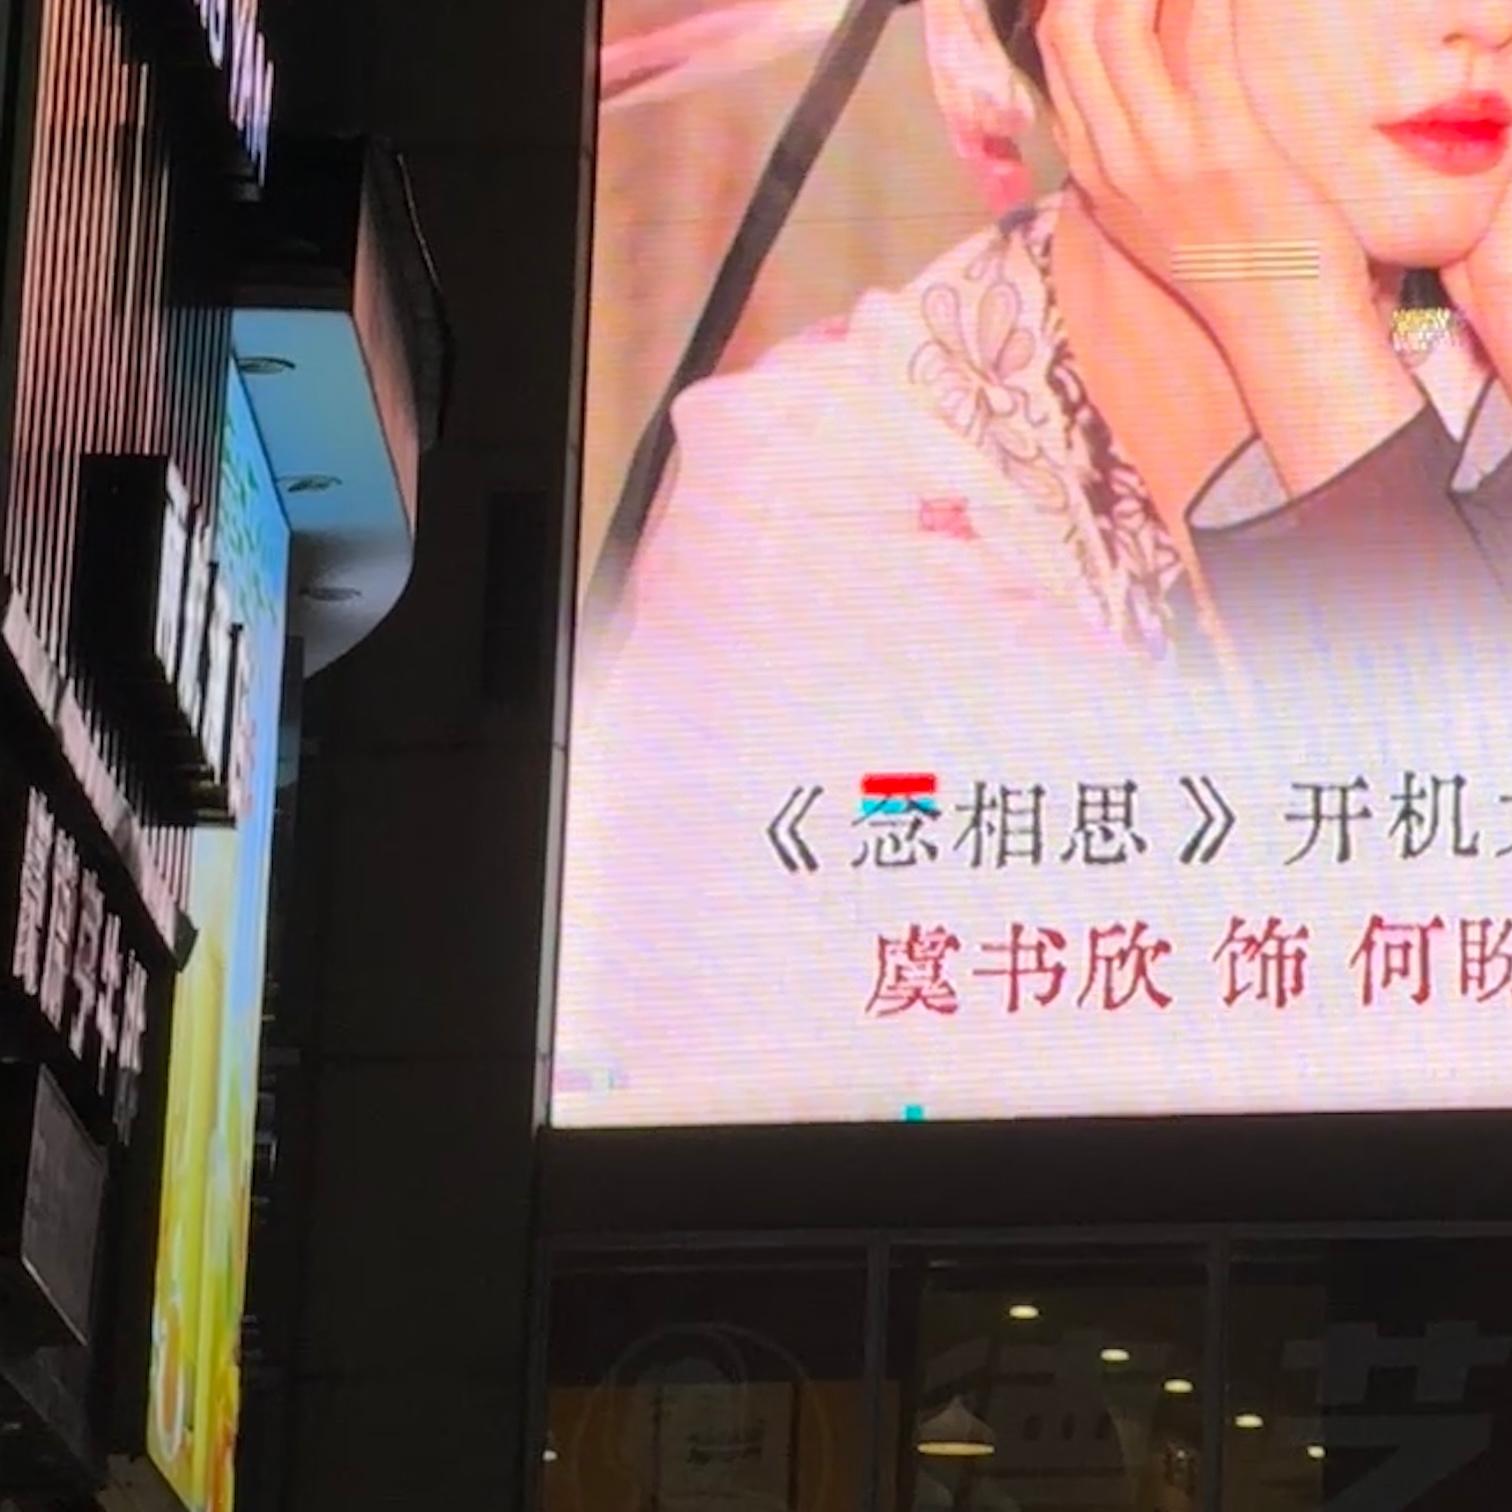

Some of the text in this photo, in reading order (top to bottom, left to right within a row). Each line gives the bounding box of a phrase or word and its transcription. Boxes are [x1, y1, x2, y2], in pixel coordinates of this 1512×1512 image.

[864, 921, 1173, 1017] 虞书欣
[1212, 914, 1311, 1010] 饰
